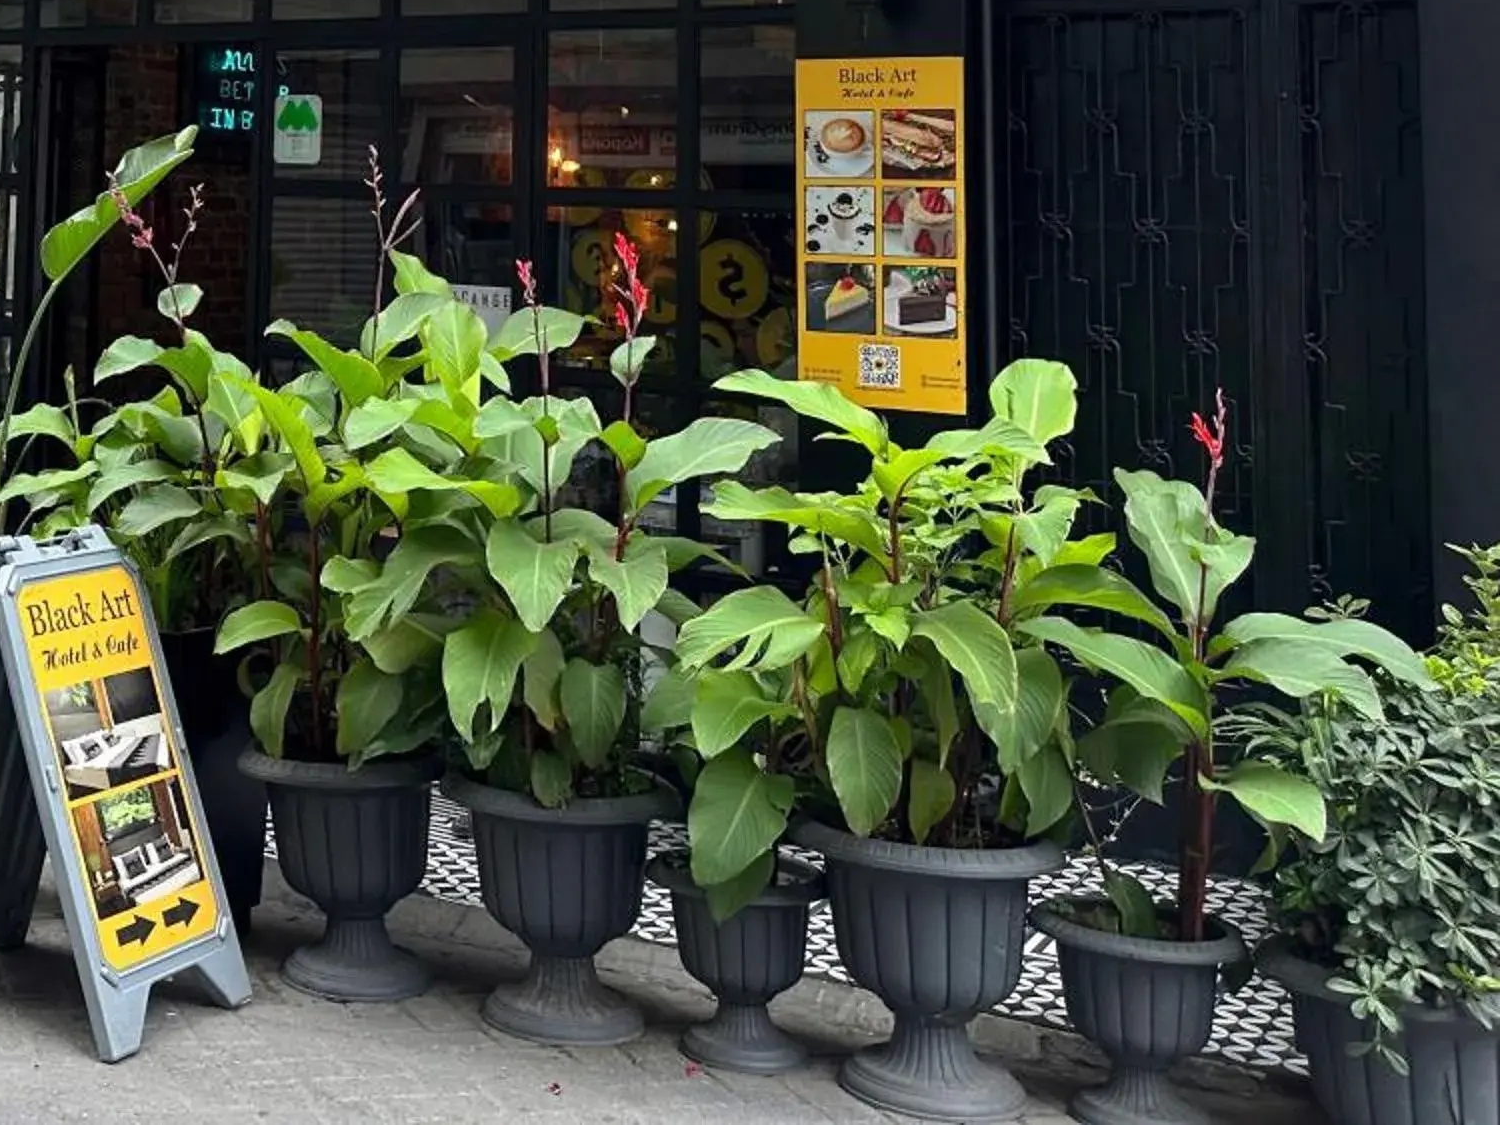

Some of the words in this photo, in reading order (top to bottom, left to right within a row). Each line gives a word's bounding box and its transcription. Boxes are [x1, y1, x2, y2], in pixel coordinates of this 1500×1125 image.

[838, 67, 885, 84] Black
[889, 67, 917, 83] Art
[27, 592, 96, 637] Black
[99, 588, 135, 622] Art
[41, 642, 87, 671] Hotel
[91, 640, 103, 660] &
[105, 630, 140, 656] Cafe
